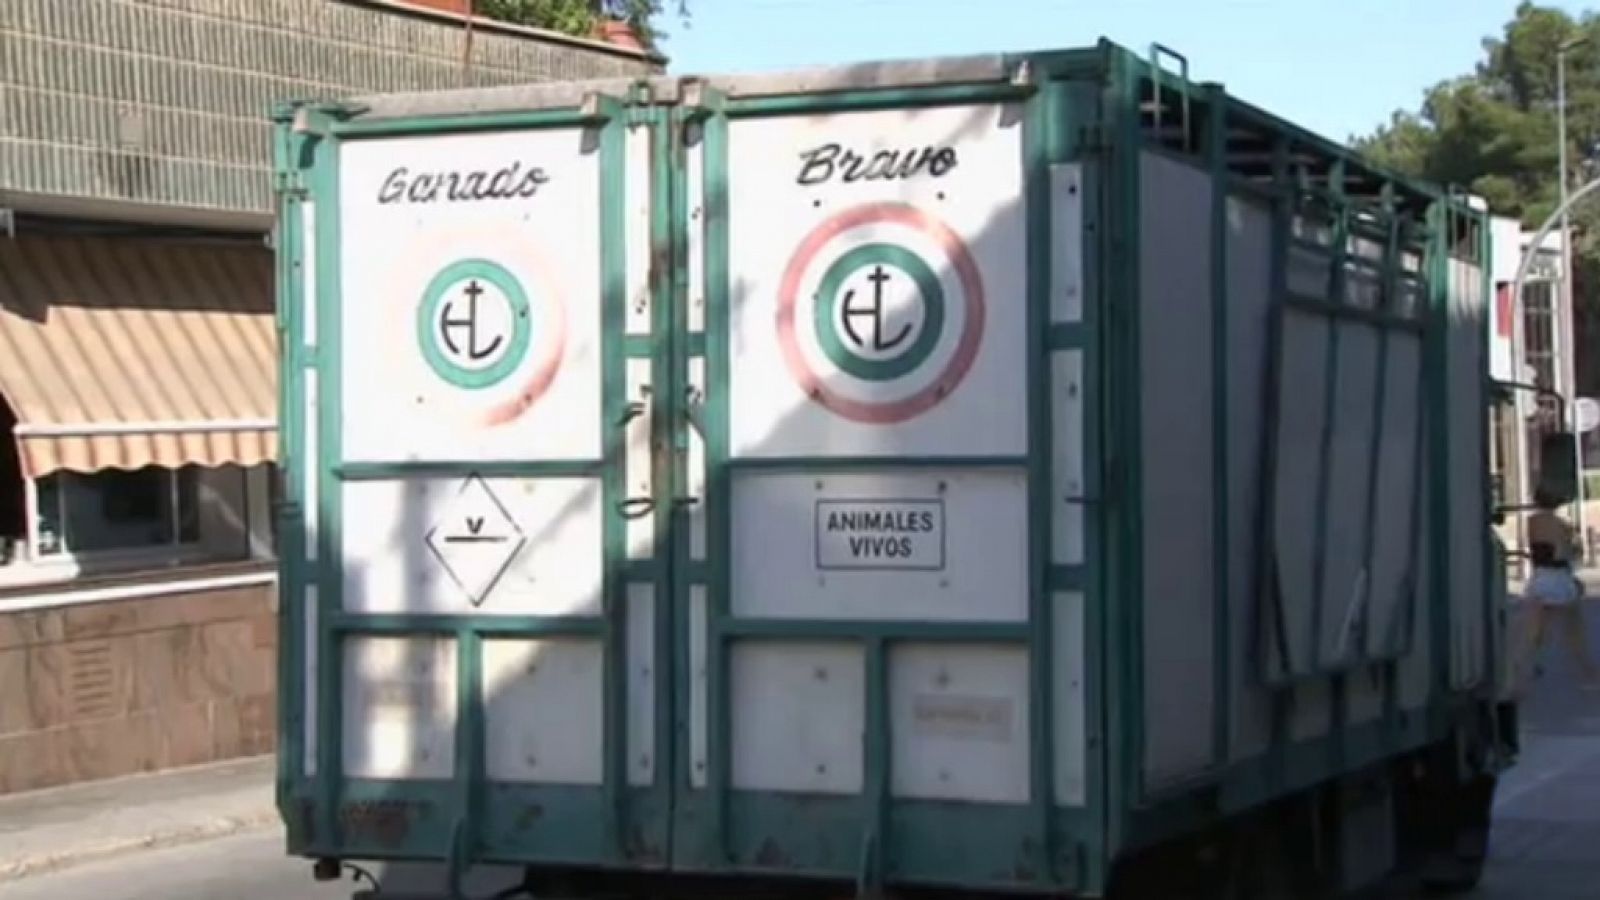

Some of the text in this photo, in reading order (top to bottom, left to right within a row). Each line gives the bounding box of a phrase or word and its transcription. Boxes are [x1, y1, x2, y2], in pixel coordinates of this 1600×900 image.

[378, 143, 958, 204] Ganado Bravo
[827, 511, 934, 532] ANIMALES
[849, 535, 912, 558] VIVOS
